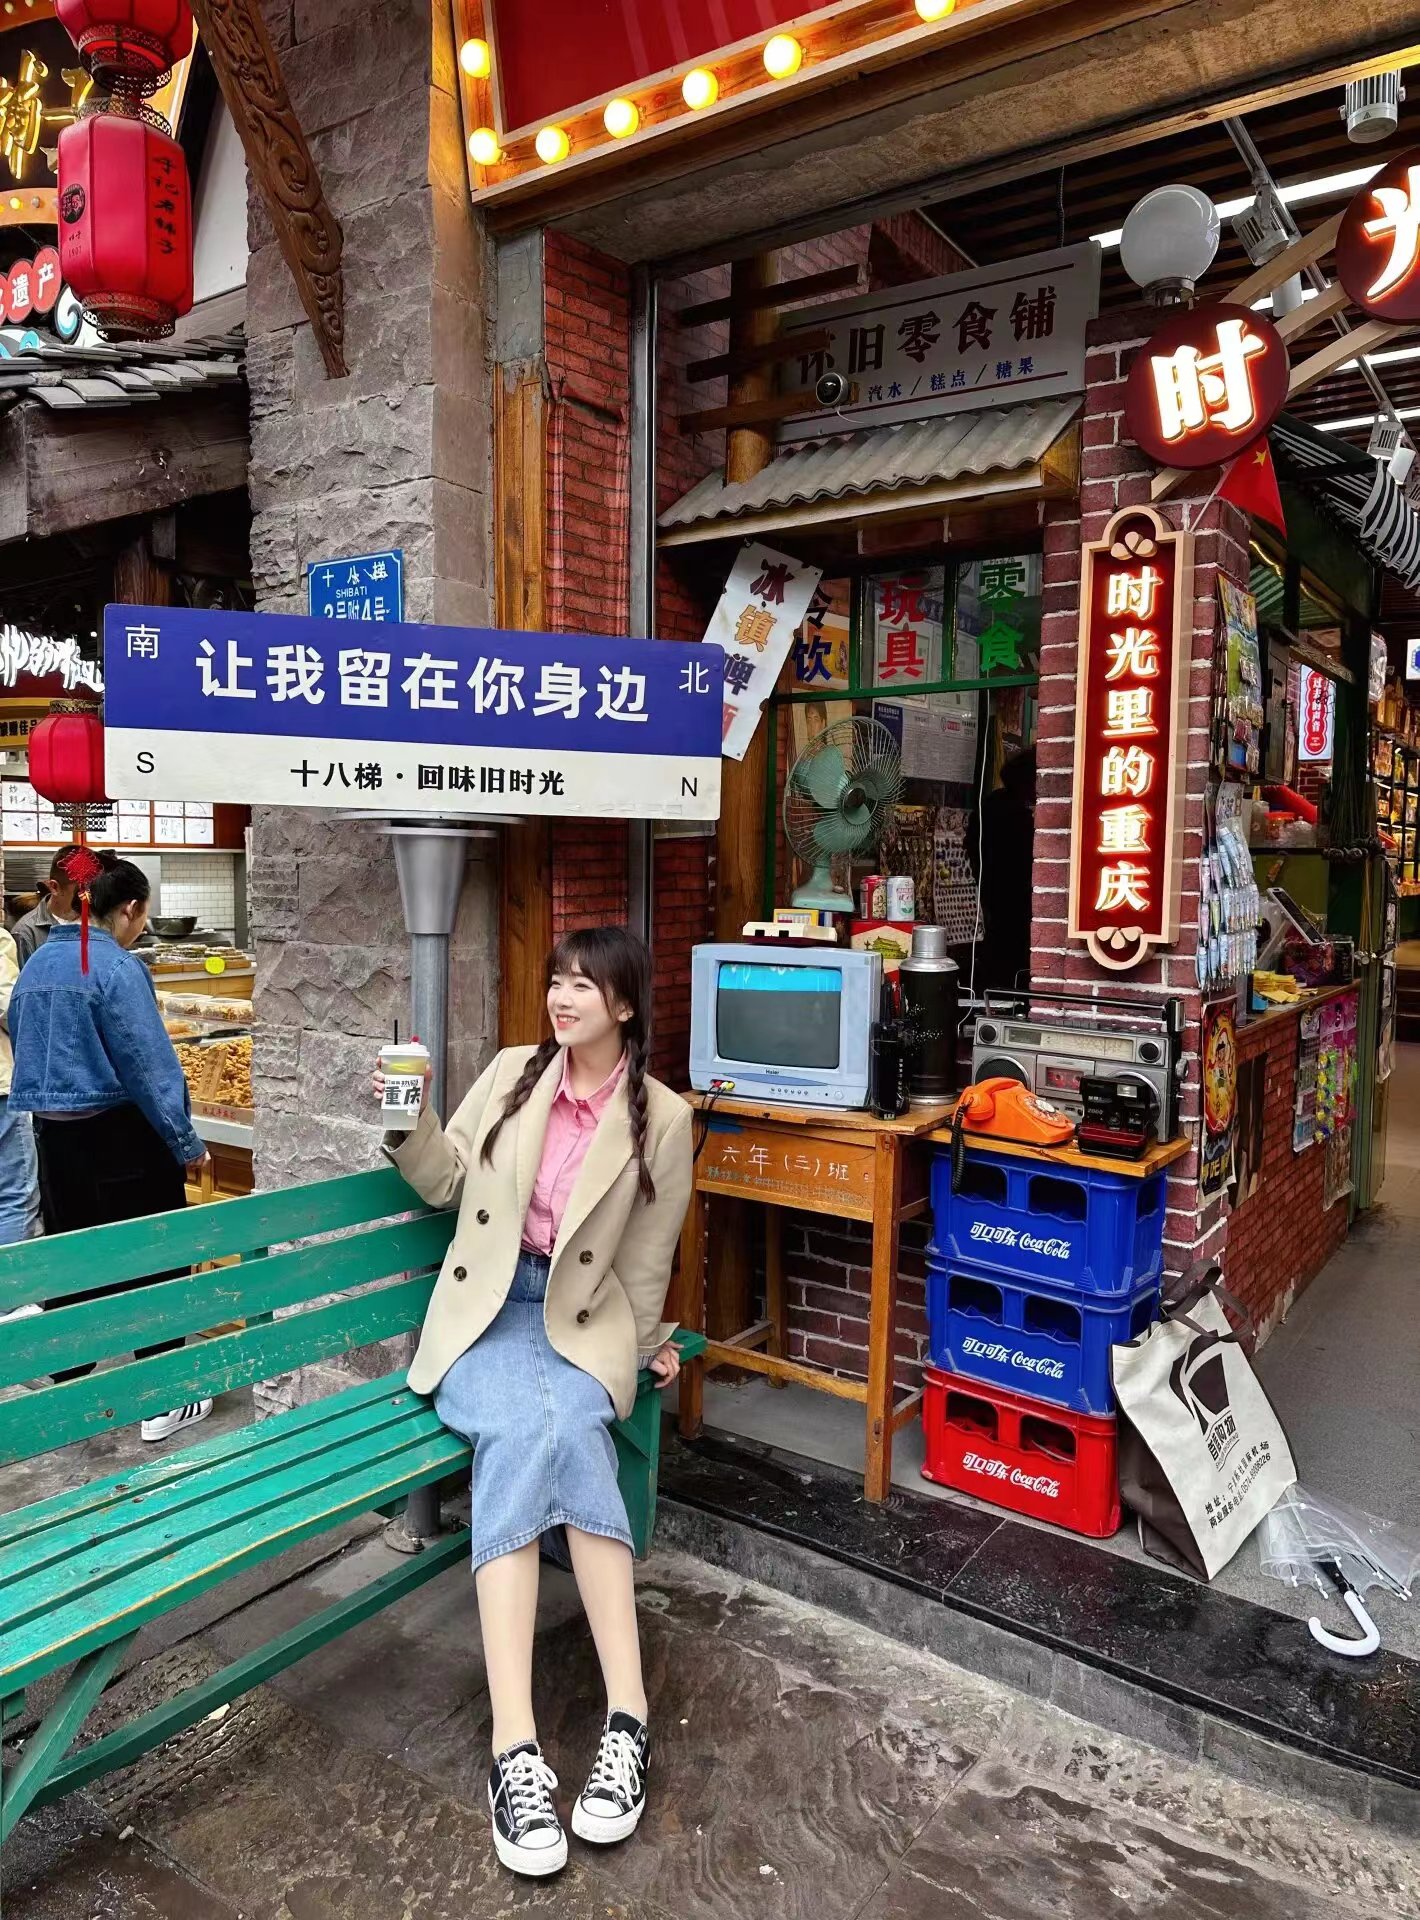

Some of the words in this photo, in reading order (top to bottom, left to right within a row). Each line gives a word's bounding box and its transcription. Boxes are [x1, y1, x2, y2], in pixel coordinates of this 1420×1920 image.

[0, 262, 55, 318] 遗产
[1151, 319, 1267, 439] 时
[335, 586, 368, 599] SHIBATI
[125, 624, 161, 659] 南
[878, 577, 926, 680] 玩具
[723, 559, 795, 742] 冰镇啤
[195, 638, 650, 723] 让我留在你身边
[678, 661, 711, 694] 北
[1095, 566, 1162, 912] 时光里的重庆
[136, 751, 156, 774] S
[290, 759, 566, 796] 十八梯·回味旧时光
[681, 776, 698, 797] N
[969, 1221, 1020, 1247] 可口可乐
[962, 1336, 1013, 1363] 可口可乐
[962, 1451, 1012, 1480] 可口可乐
